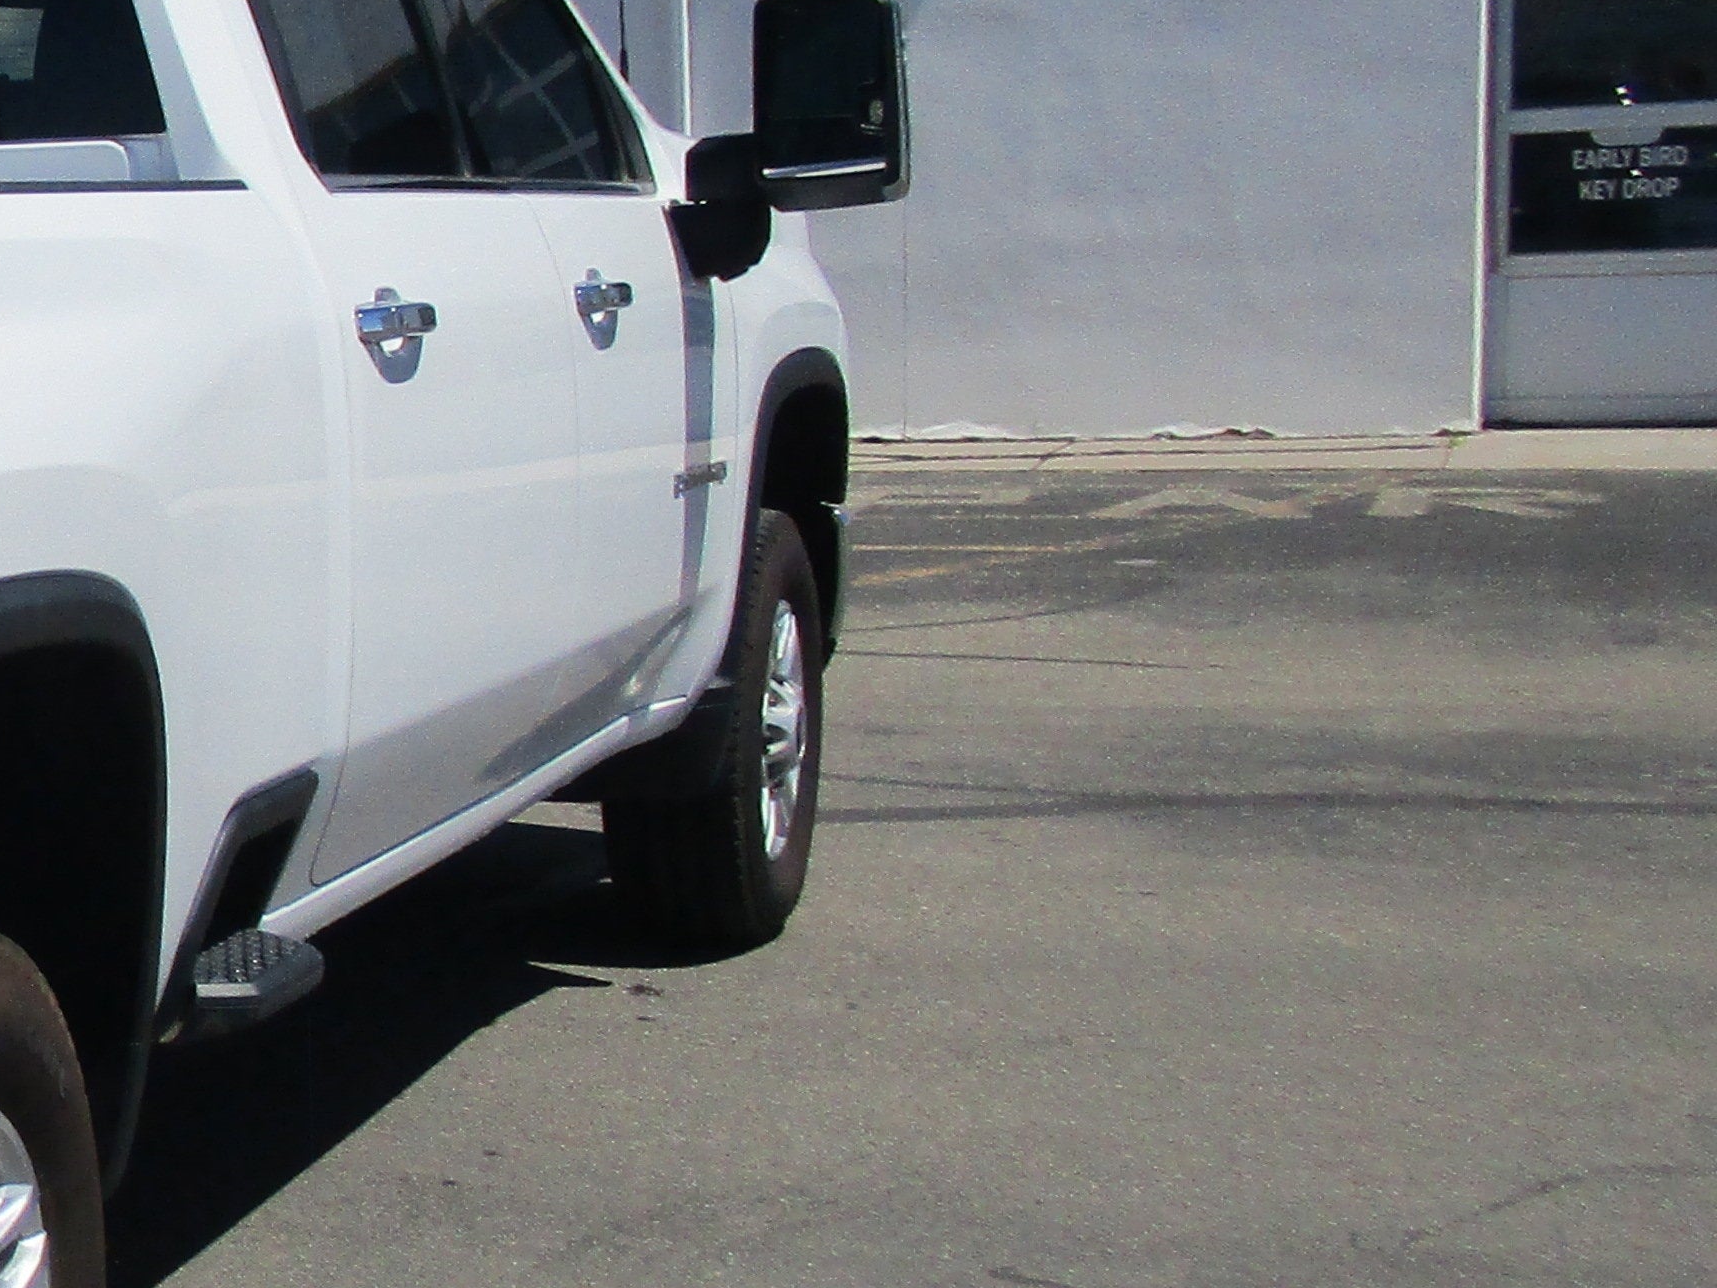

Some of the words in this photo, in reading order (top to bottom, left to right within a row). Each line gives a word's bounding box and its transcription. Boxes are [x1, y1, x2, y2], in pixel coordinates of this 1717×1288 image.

[1571, 147, 1634, 170] EARLY
[1578, 179, 1617, 200] KEY
[1621, 176, 1681, 199] DROP
